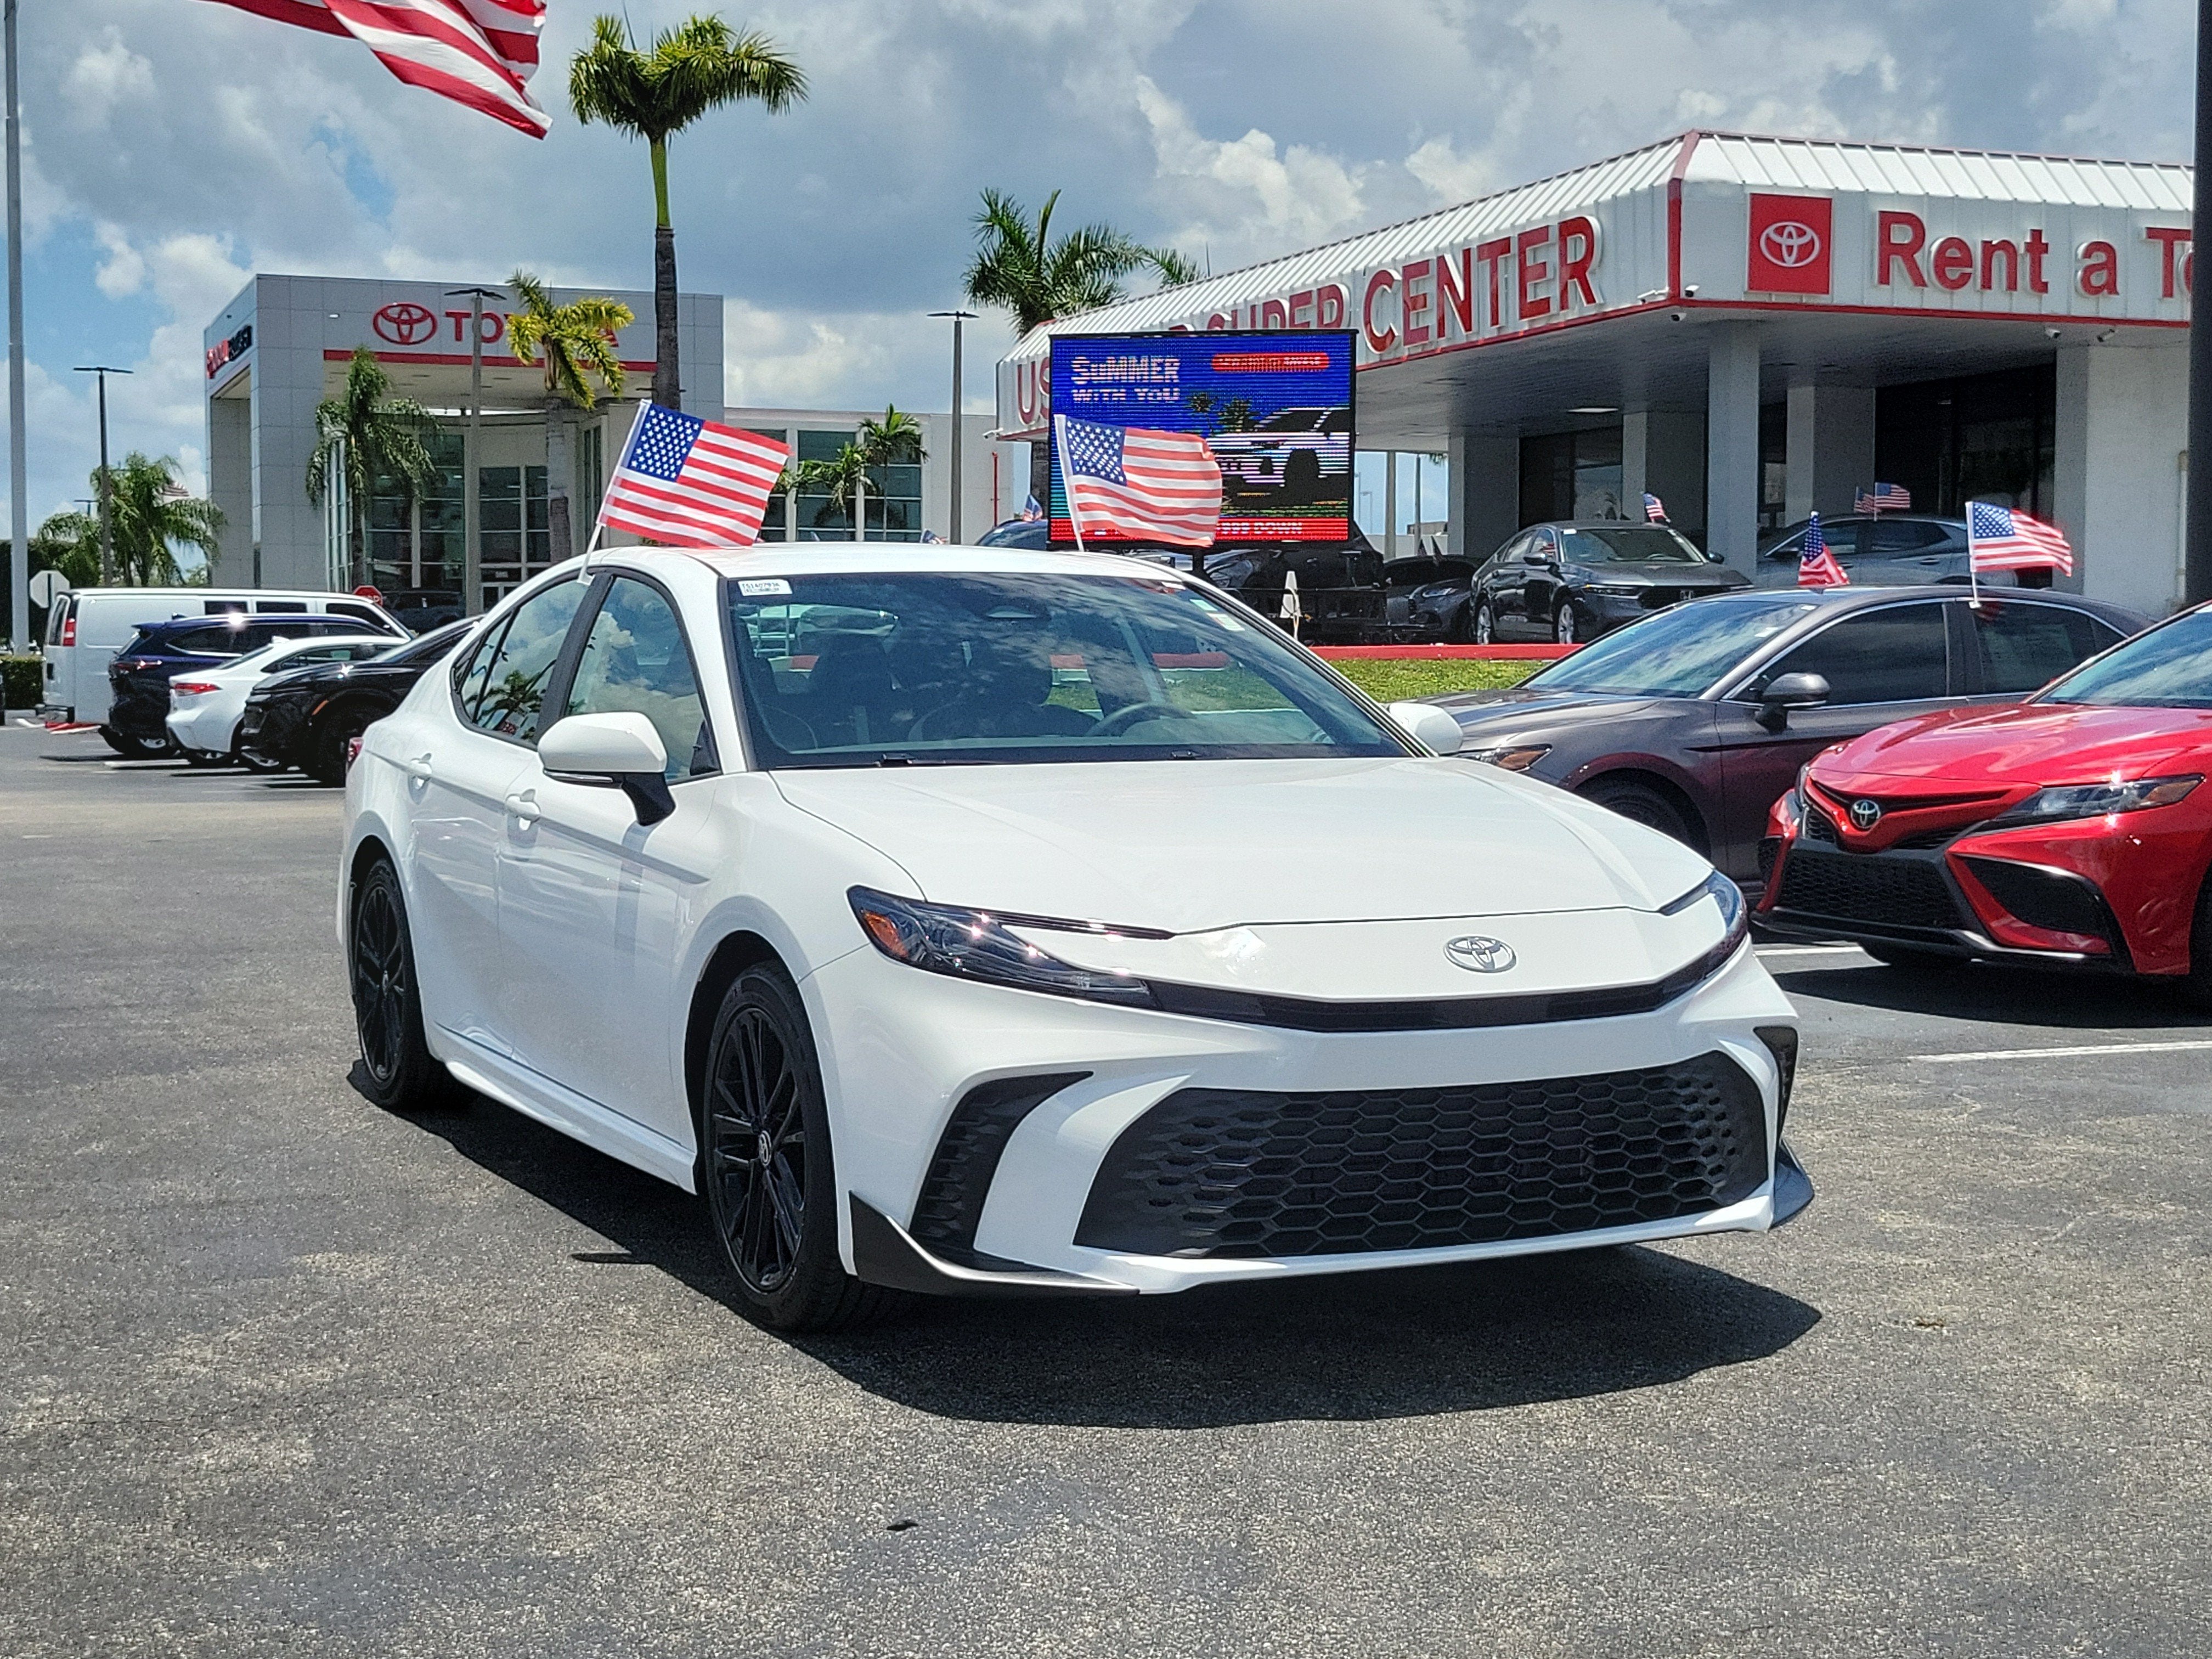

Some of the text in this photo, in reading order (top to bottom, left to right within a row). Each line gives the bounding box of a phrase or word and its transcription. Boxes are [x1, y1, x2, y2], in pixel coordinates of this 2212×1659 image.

[1364, 216, 1597, 353] CENTER
[1878, 210, 2193, 298] Rent a T
